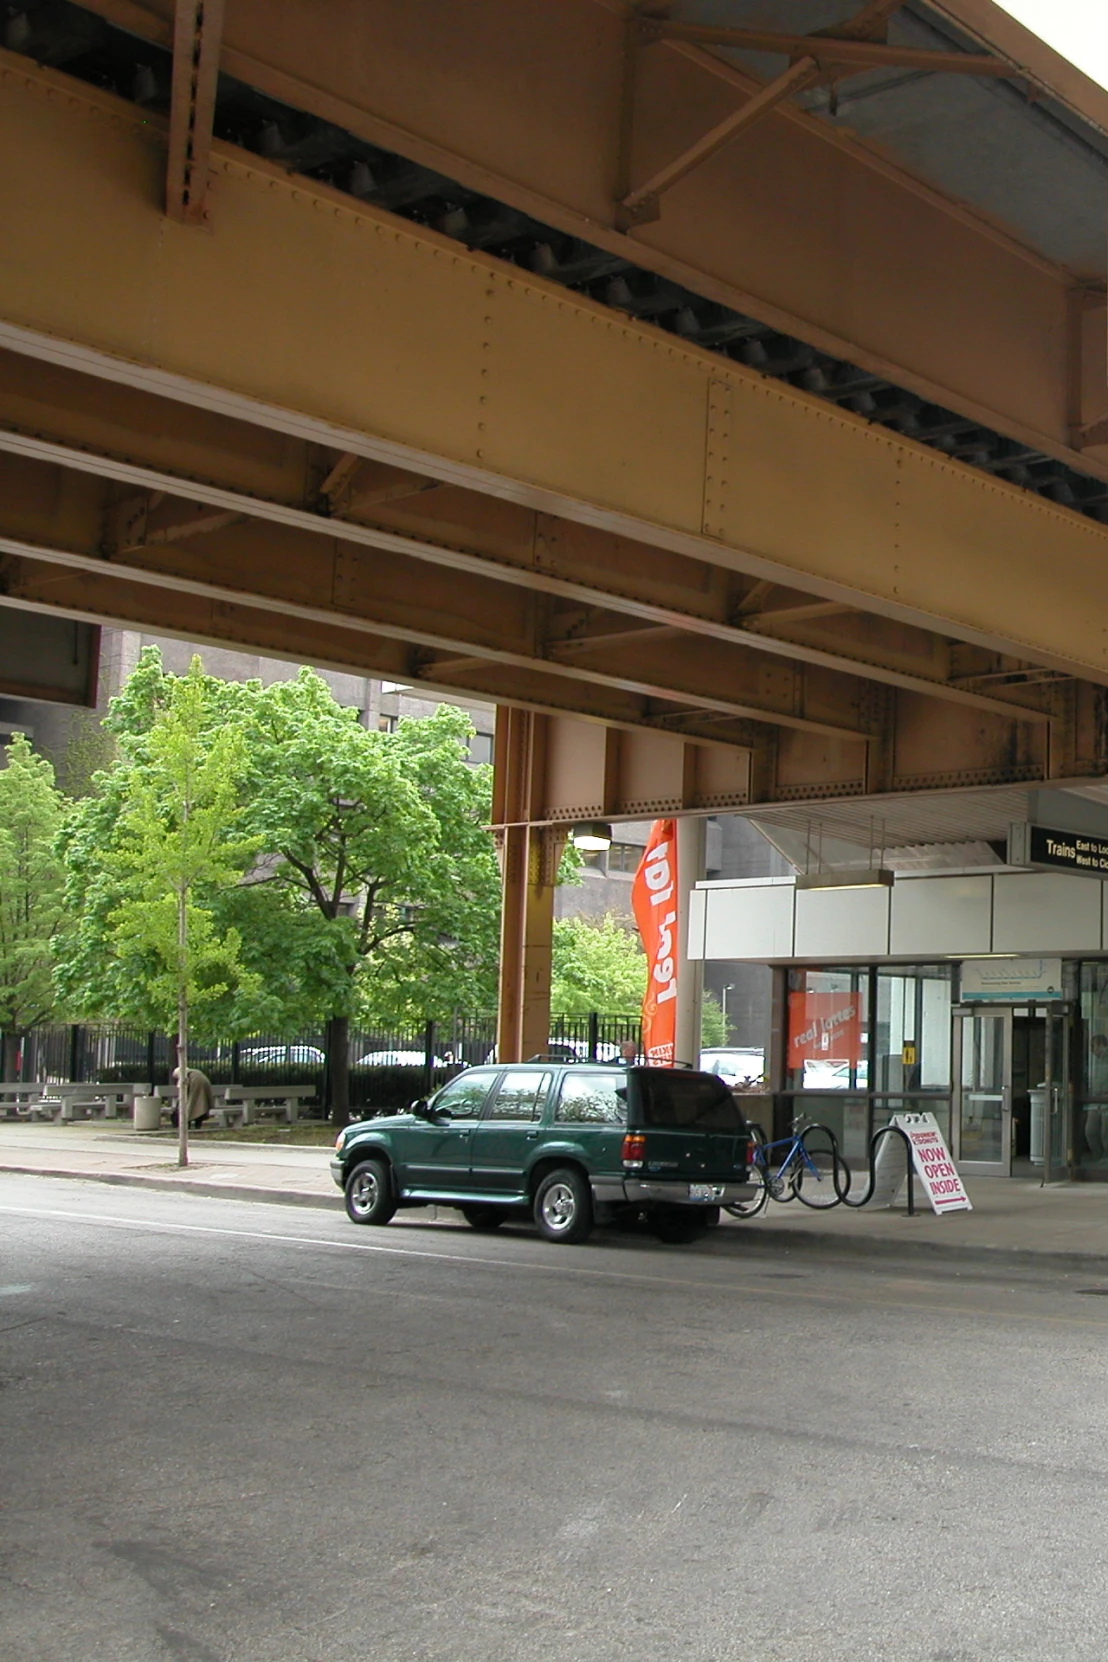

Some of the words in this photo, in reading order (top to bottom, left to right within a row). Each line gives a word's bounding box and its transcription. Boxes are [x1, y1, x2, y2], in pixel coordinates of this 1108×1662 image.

[1046, 839, 1076, 859] Trains
[1076, 840, 1090, 852] East
[1091, 843, 1098, 853] to
[1076, 855, 1091, 866] West
[1092, 857, 1099, 867] to
[794, 1021, 818, 1048] real
[821, 1006, 856, 1032] lattes
[918, 1147, 946, 1162] NOW
[924, 1163, 955, 1178] OPEN
[929, 1179, 961, 1195] INSIDE
